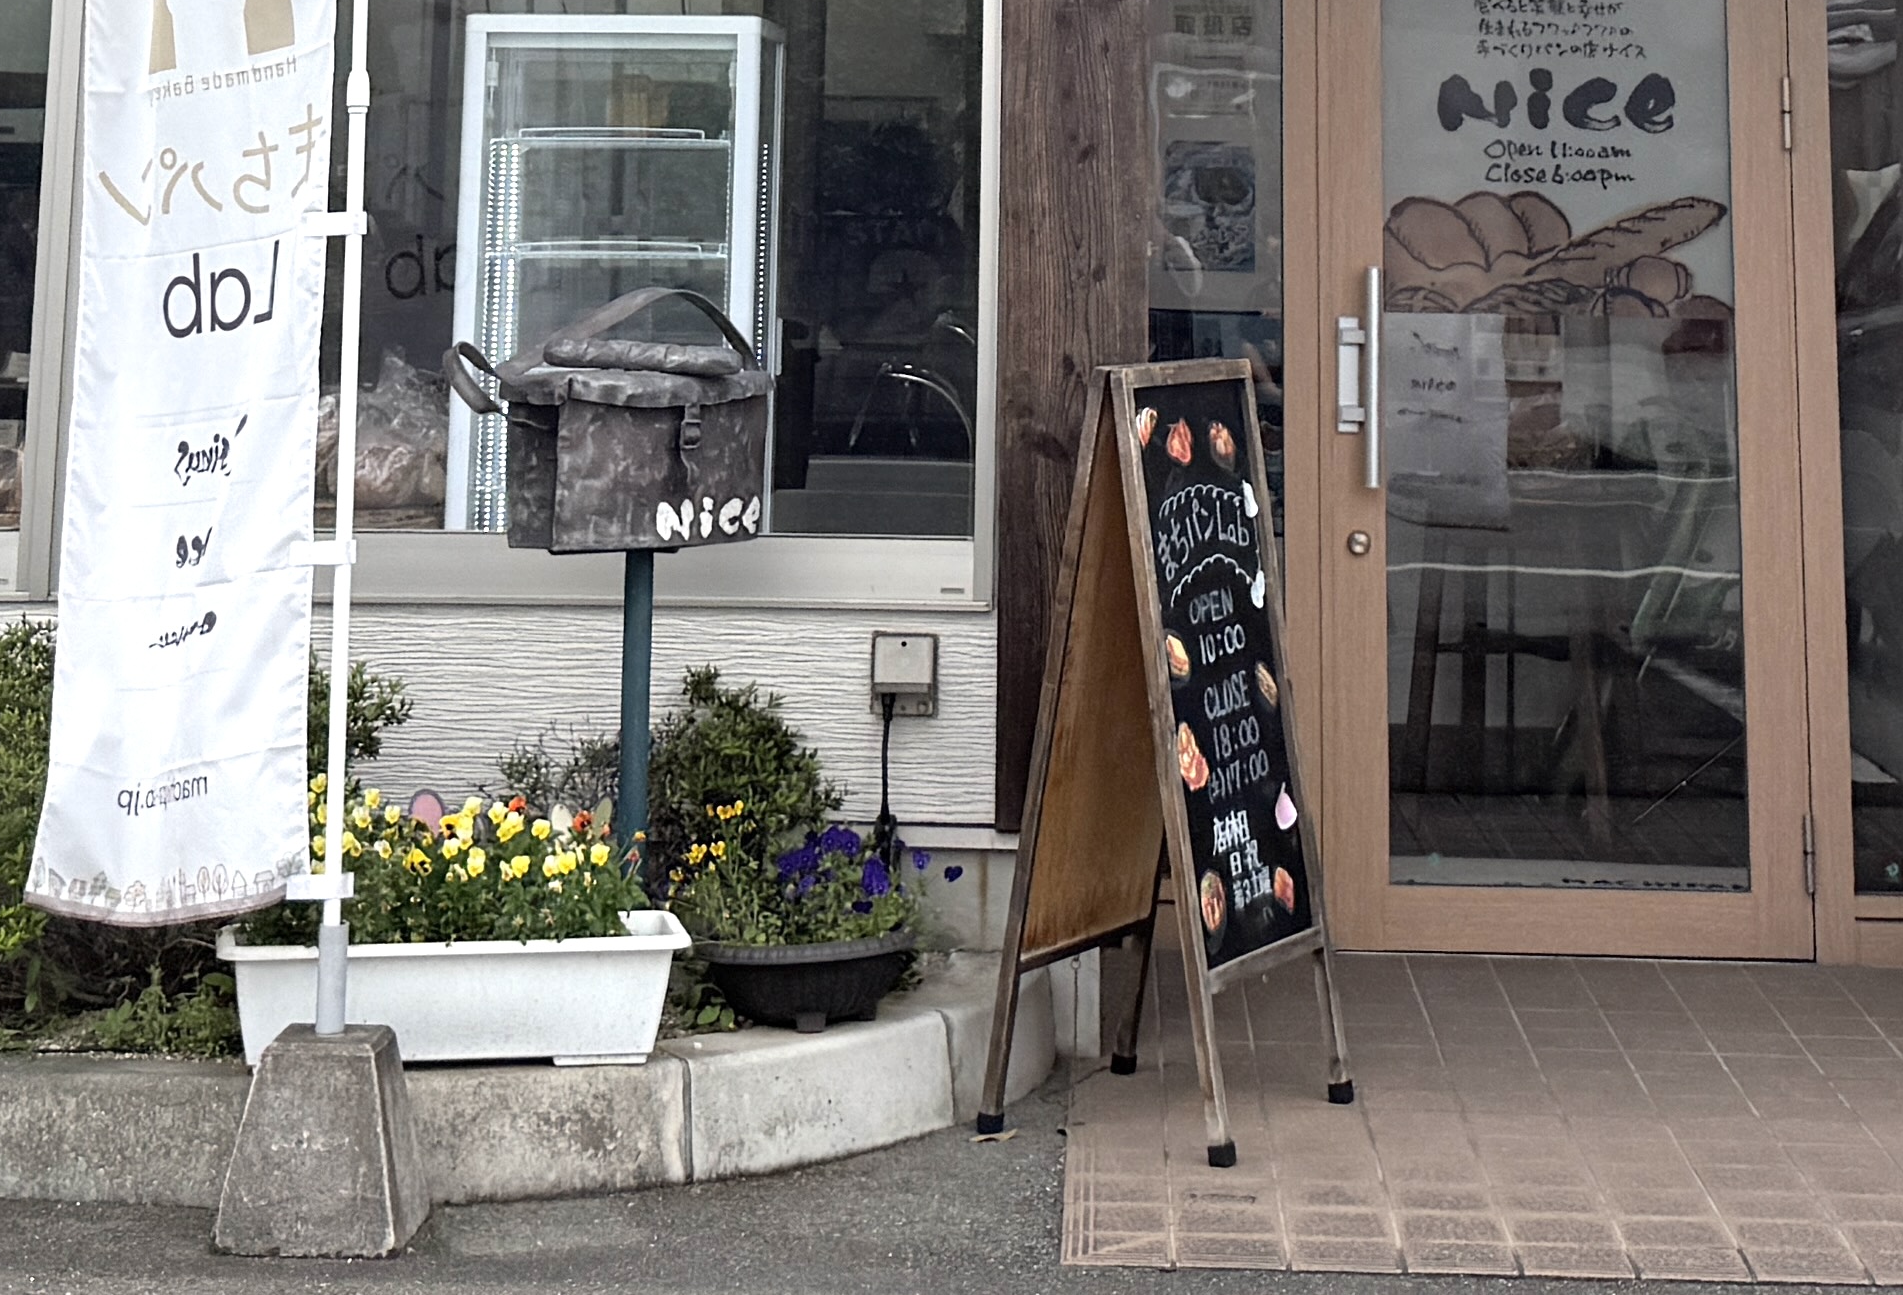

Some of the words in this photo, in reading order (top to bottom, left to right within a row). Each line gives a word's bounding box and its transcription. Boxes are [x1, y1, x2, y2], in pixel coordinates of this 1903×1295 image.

[1484, 139, 1543, 161] Open
[1189, 585, 1234, 625] OPEN
[1199, 623, 1246, 666] 10:00
[1204, 670, 1251, 721] CLOSE
[1213, 715, 1260, 762] 18:00
